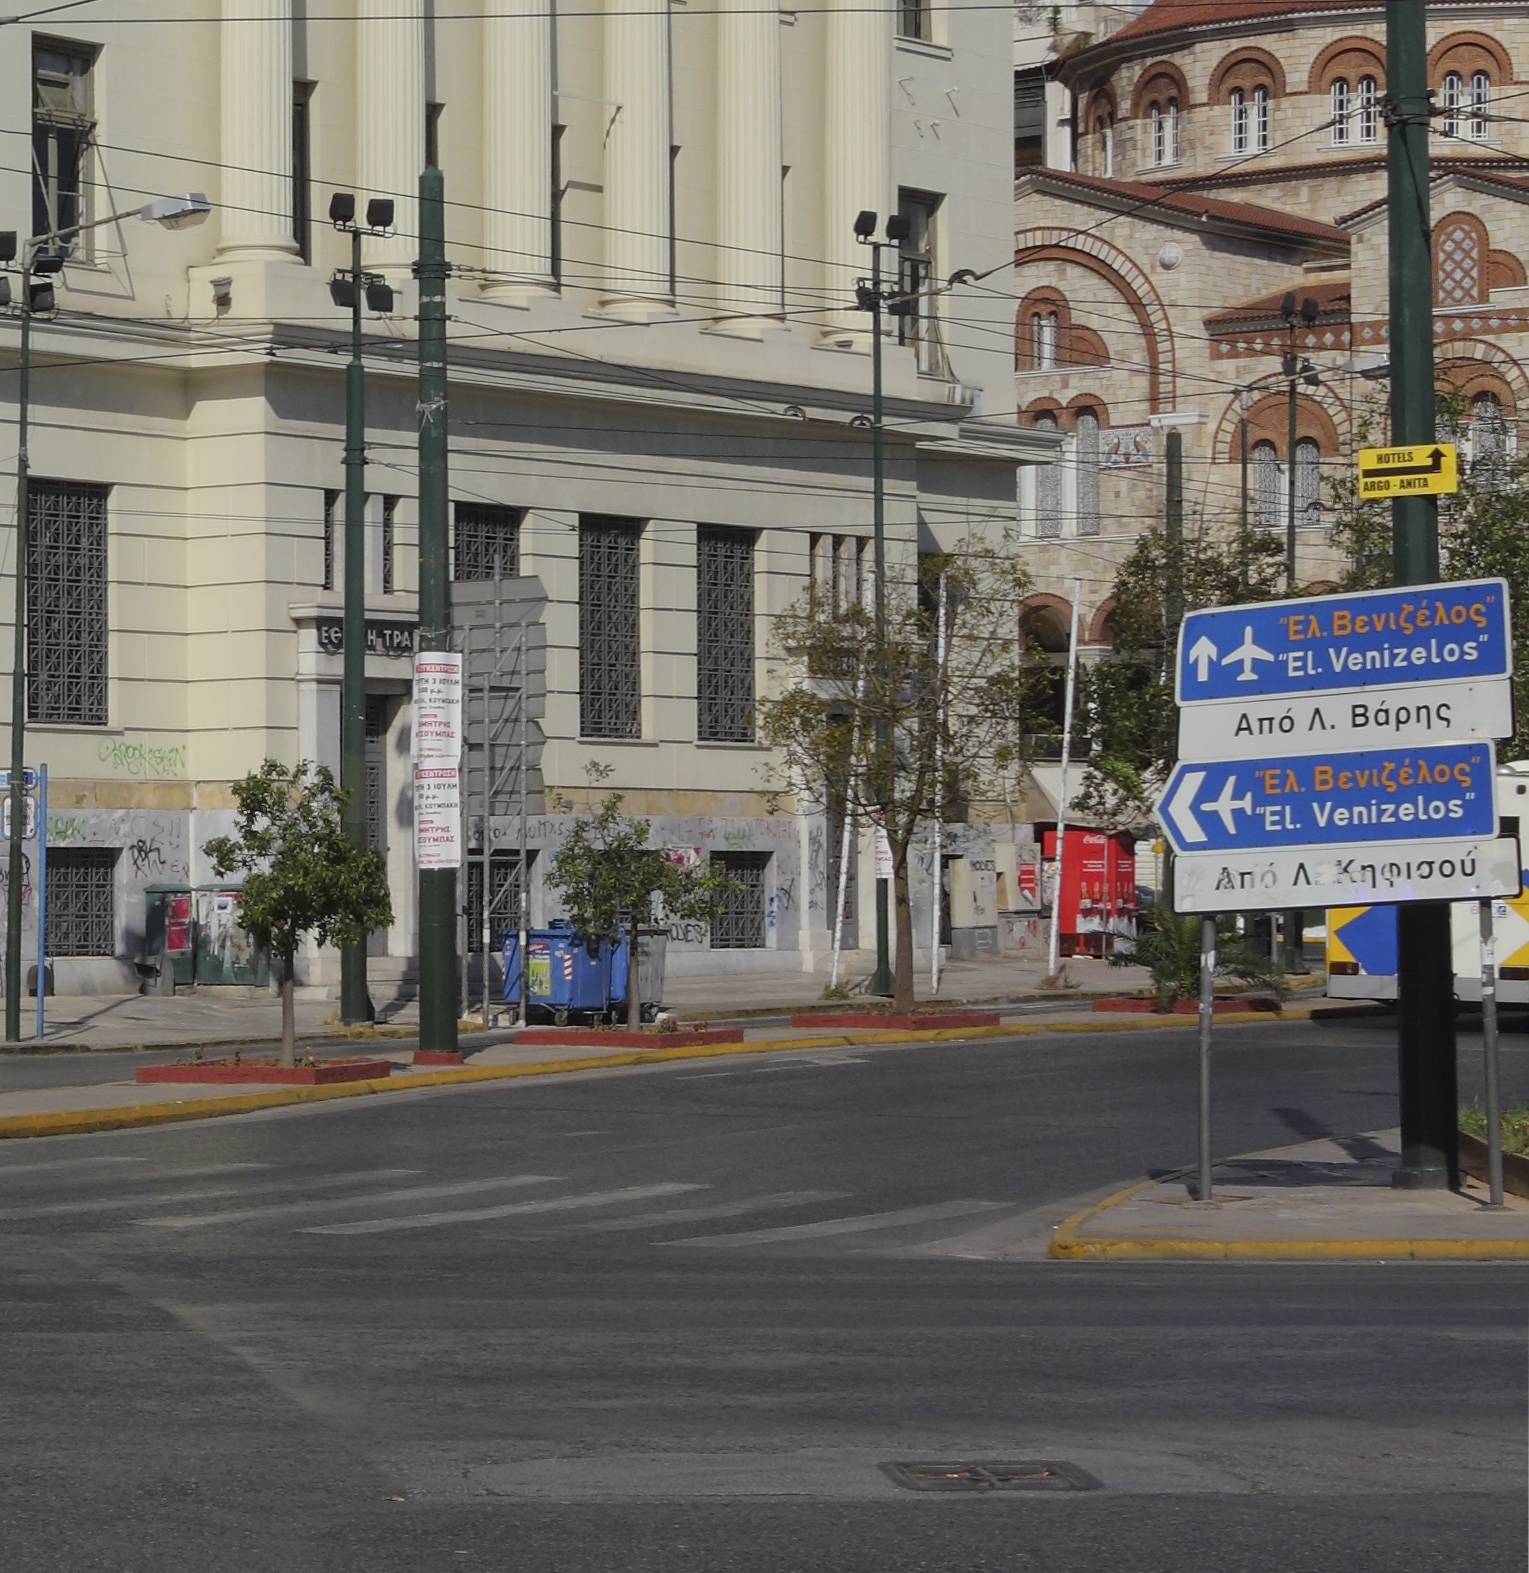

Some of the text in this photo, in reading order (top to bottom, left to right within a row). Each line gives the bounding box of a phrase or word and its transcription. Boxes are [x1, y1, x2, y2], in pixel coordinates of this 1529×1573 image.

[1376, 451, 1414, 464] HOTELS
[1363, 480, 1391, 492] ARGO
[1398, 478, 1430, 490] ANITA
[1234, 700, 1452, 737] Από Λ. Βάρης
